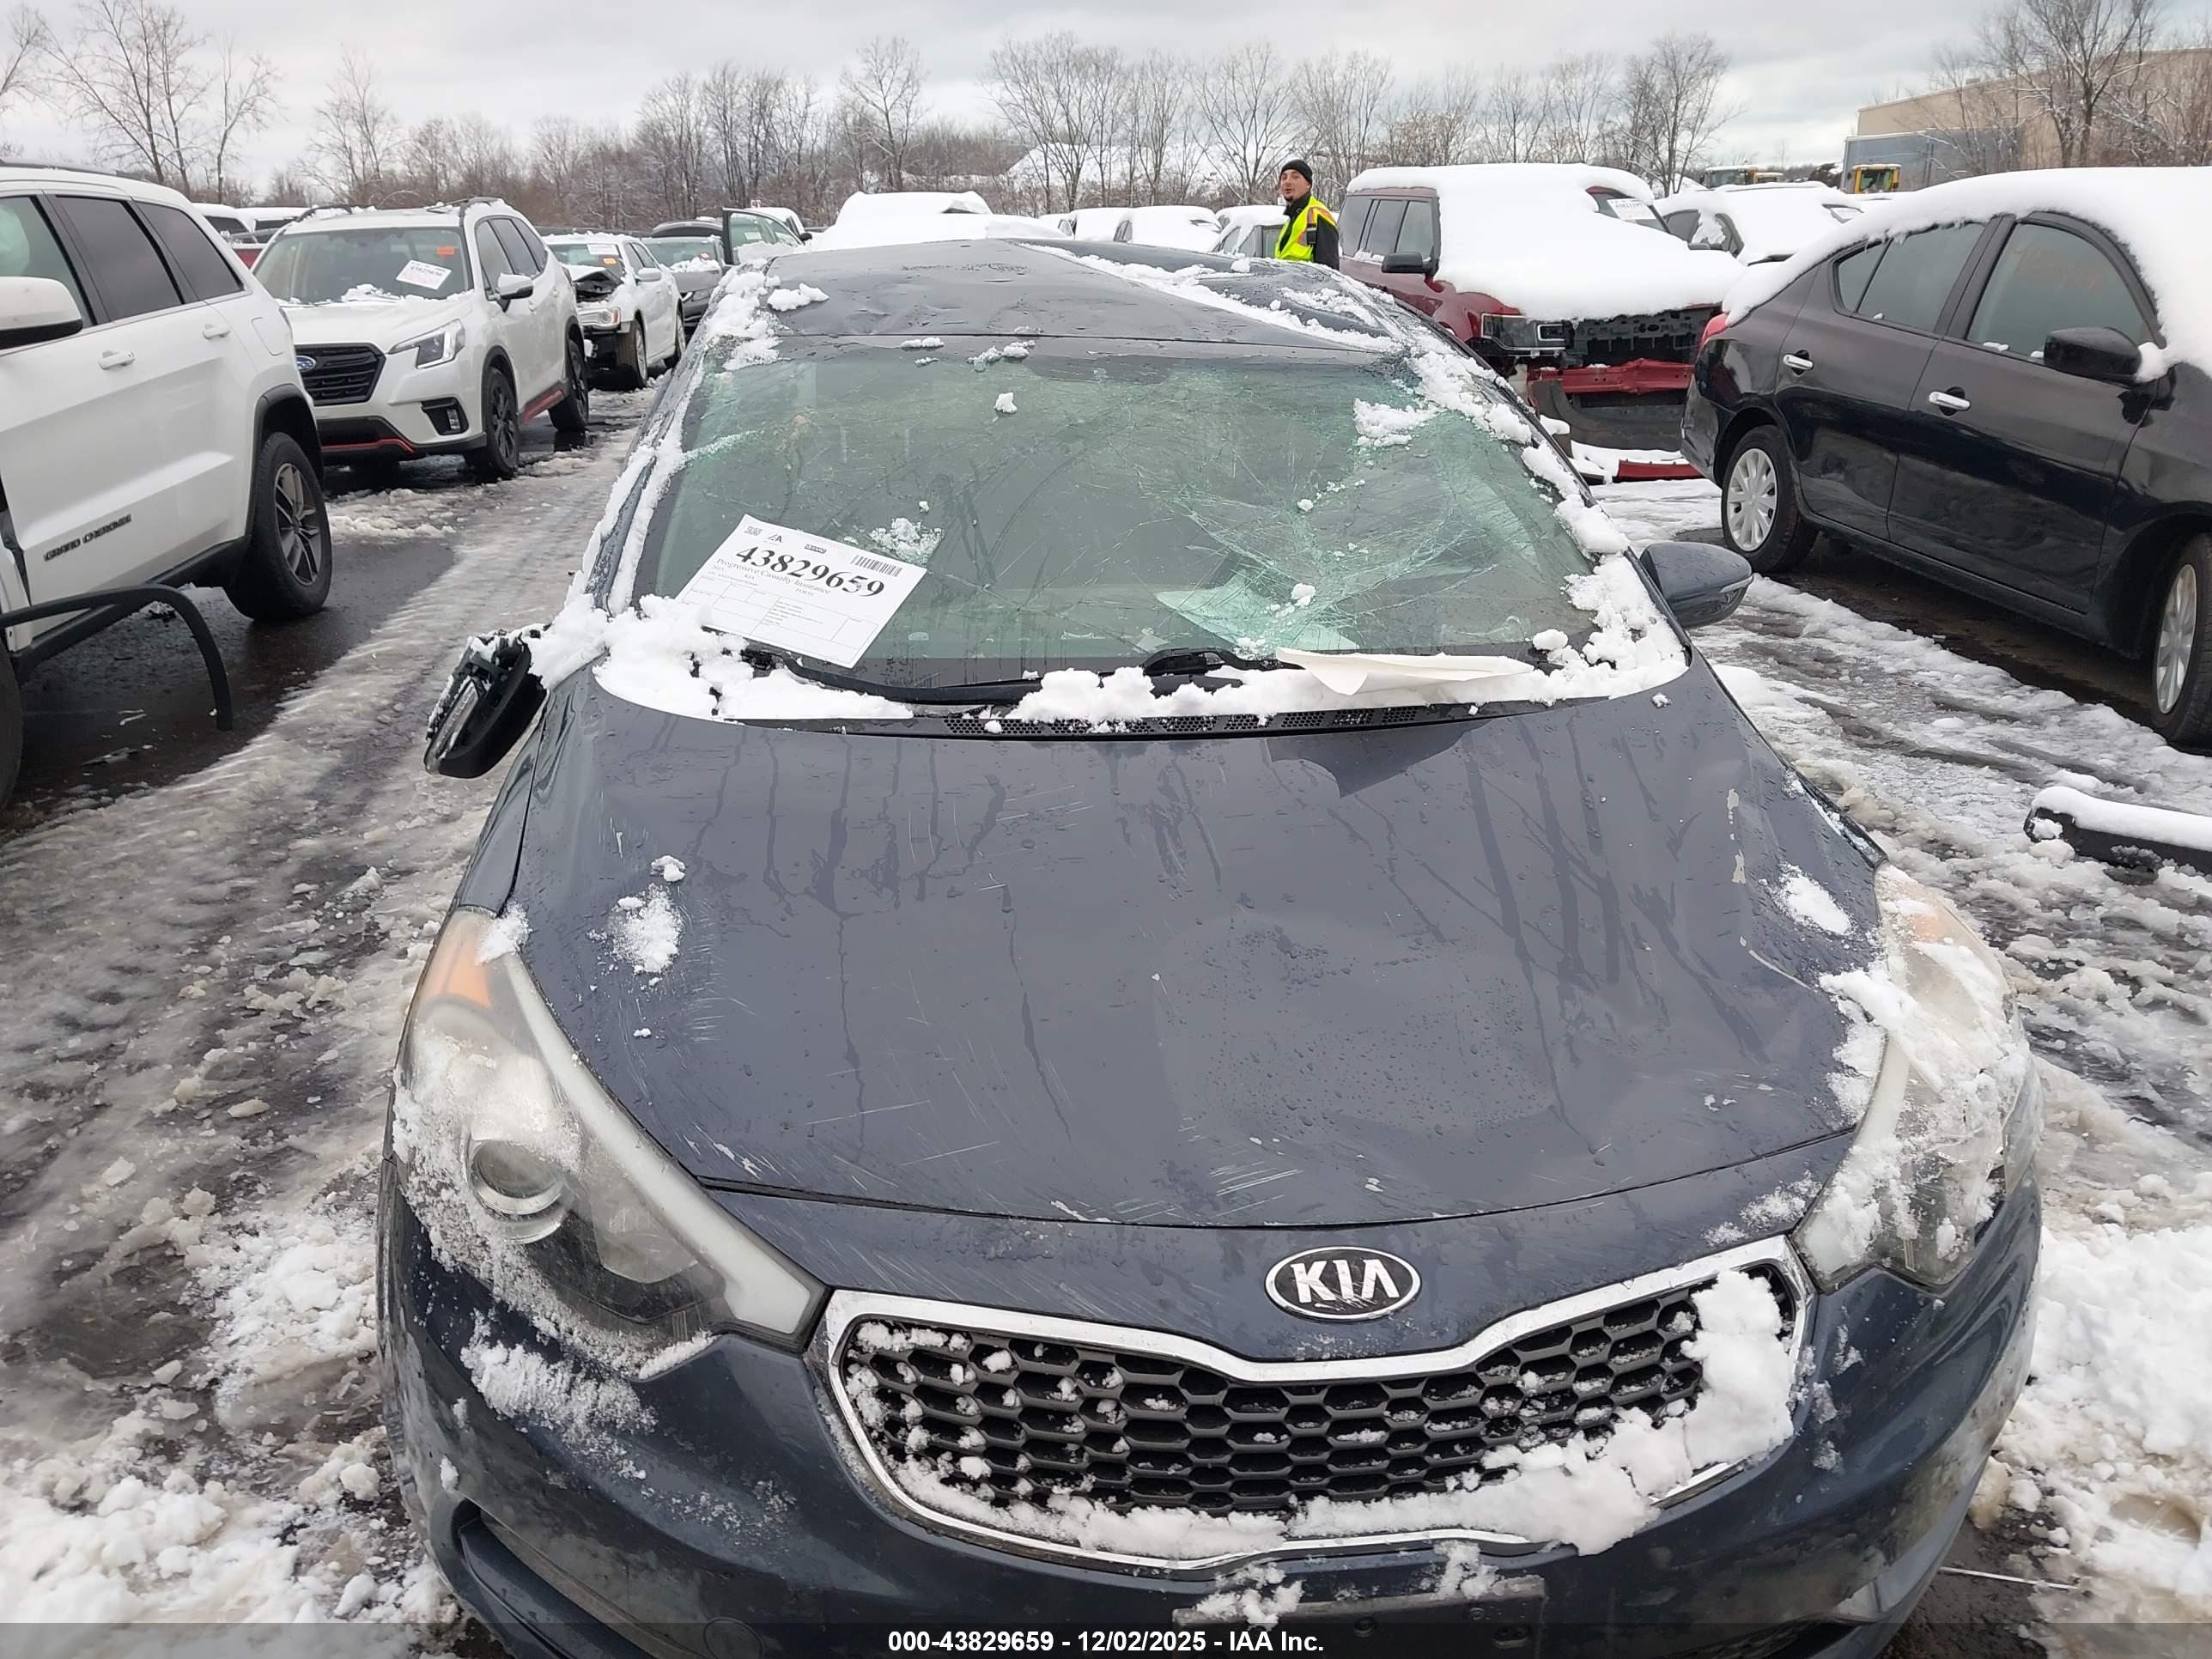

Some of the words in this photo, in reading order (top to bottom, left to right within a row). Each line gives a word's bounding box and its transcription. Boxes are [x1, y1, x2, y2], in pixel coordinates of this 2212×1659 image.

[716, 558, 759, 574] Progressive
[760, 569, 791, 585] Casualty
[793, 579, 831, 595] Insurance
[736, 546, 884, 597] 43829659
[1290, 1259, 1401, 1304] KIA
